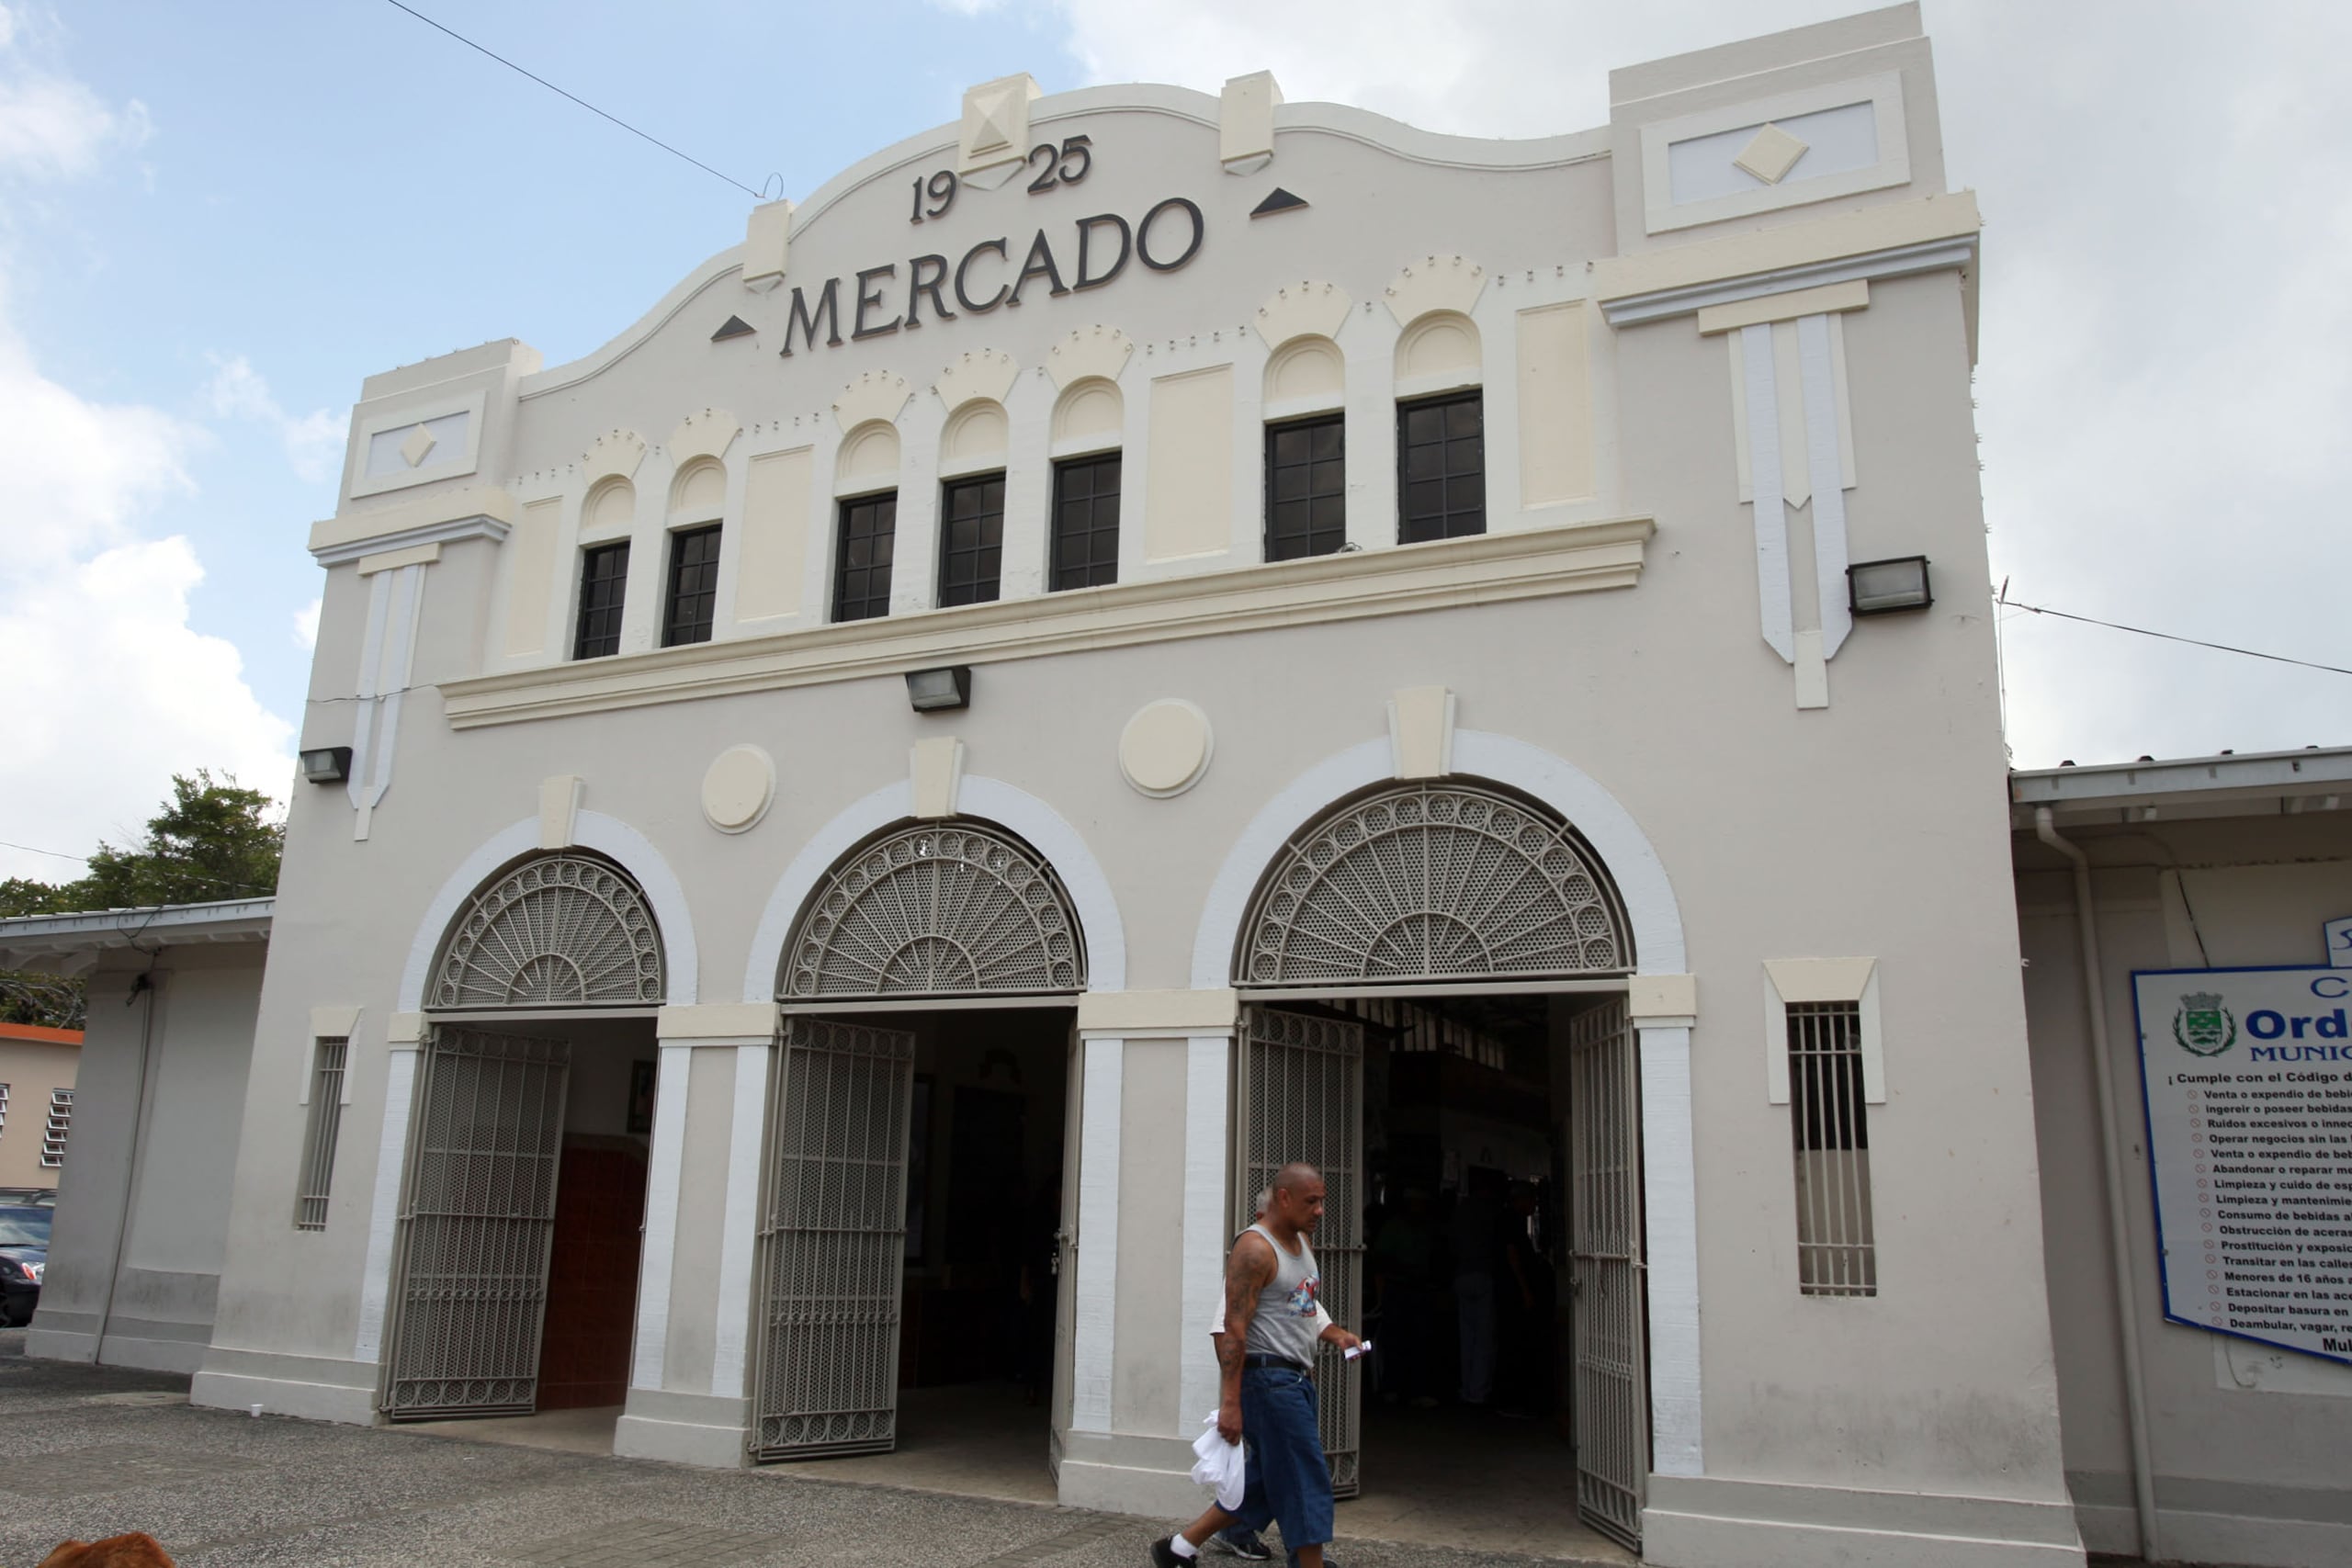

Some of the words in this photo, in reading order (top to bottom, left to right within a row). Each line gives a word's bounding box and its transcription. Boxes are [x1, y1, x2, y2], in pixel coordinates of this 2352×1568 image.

[910, 168, 957, 224] 19
[1026, 134, 1092, 195] 25
[778, 197, 1205, 357] MERCADO
[2177, 1073, 2232, 1085] Cumple
[2236, 1074, 2263, 1082] con
[2268, 1073, 2280, 1082] el
[2286, 1072, 2338, 1084] Código
[2204, 1090, 2237, 1099] Venta
[2252, 1089, 2304, 1100] expendio
[2308, 1089, 2322, 1098] de
[2325, 1089, 2352, 1098] bebi
[2265, 1106, 2303, 1114] poseer
[2208, 1119, 2246, 1128] Ruidos
[2250, 1119, 2307, 1128] excesivos
[2210, 1134, 2248, 1145] Operar
[2252, 1134, 2304, 1145] negocios
[2309, 1134, 2325, 1144] sin
[2330, 1134, 2347, 1144] las
[2211, 1150, 2244, 1158] Venta
[2258, 1150, 2312, 1160] expendio
[2315, 1150, 2330, 1158] de
[2213, 1165, 2275, 1173] Abandonar
[2290, 1167, 2333, 1175] reparar
[2214, 1179, 2266, 1190] Limpieza
[2269, 1182, 2276, 1190] y
[2280, 1180, 2312, 1189] cuido
[2316, 1180, 2330, 1190] de
[2216, 1195, 2267, 1205] Limpieza
[2272, 1198, 2278, 1206] y
[2218, 1211, 2271, 1219] Consumo
[2276, 1211, 2290, 1220] de
[2293, 1212, 2340, 1221] bebidas
[2220, 1225, 2291, 1235] Obstrucción
[2295, 1227, 2309, 1235] de
[2222, 1241, 2292, 1250] Prostitución
[2297, 1245, 2302, 1253] y
[2223, 1257, 2277, 1266] Transitar
[2299, 1258, 2315, 1268] las
[2224, 1272, 2275, 1282] Menores
[2278, 1273, 2293, 1282] de
[2299, 1274, 2312, 1282] 16
[2315, 1275, 2344, 1284] años
[2227, 1288, 2290, 1298] Estacionar
[2312, 1291, 2329, 1300] las
[2228, 1303, 2285, 1314] Depositar
[2289, 1305, 2330, 1315] basura
[2230, 1319, 2297, 1332] Deambular,
[2301, 1324, 2337, 1333] vagar,
